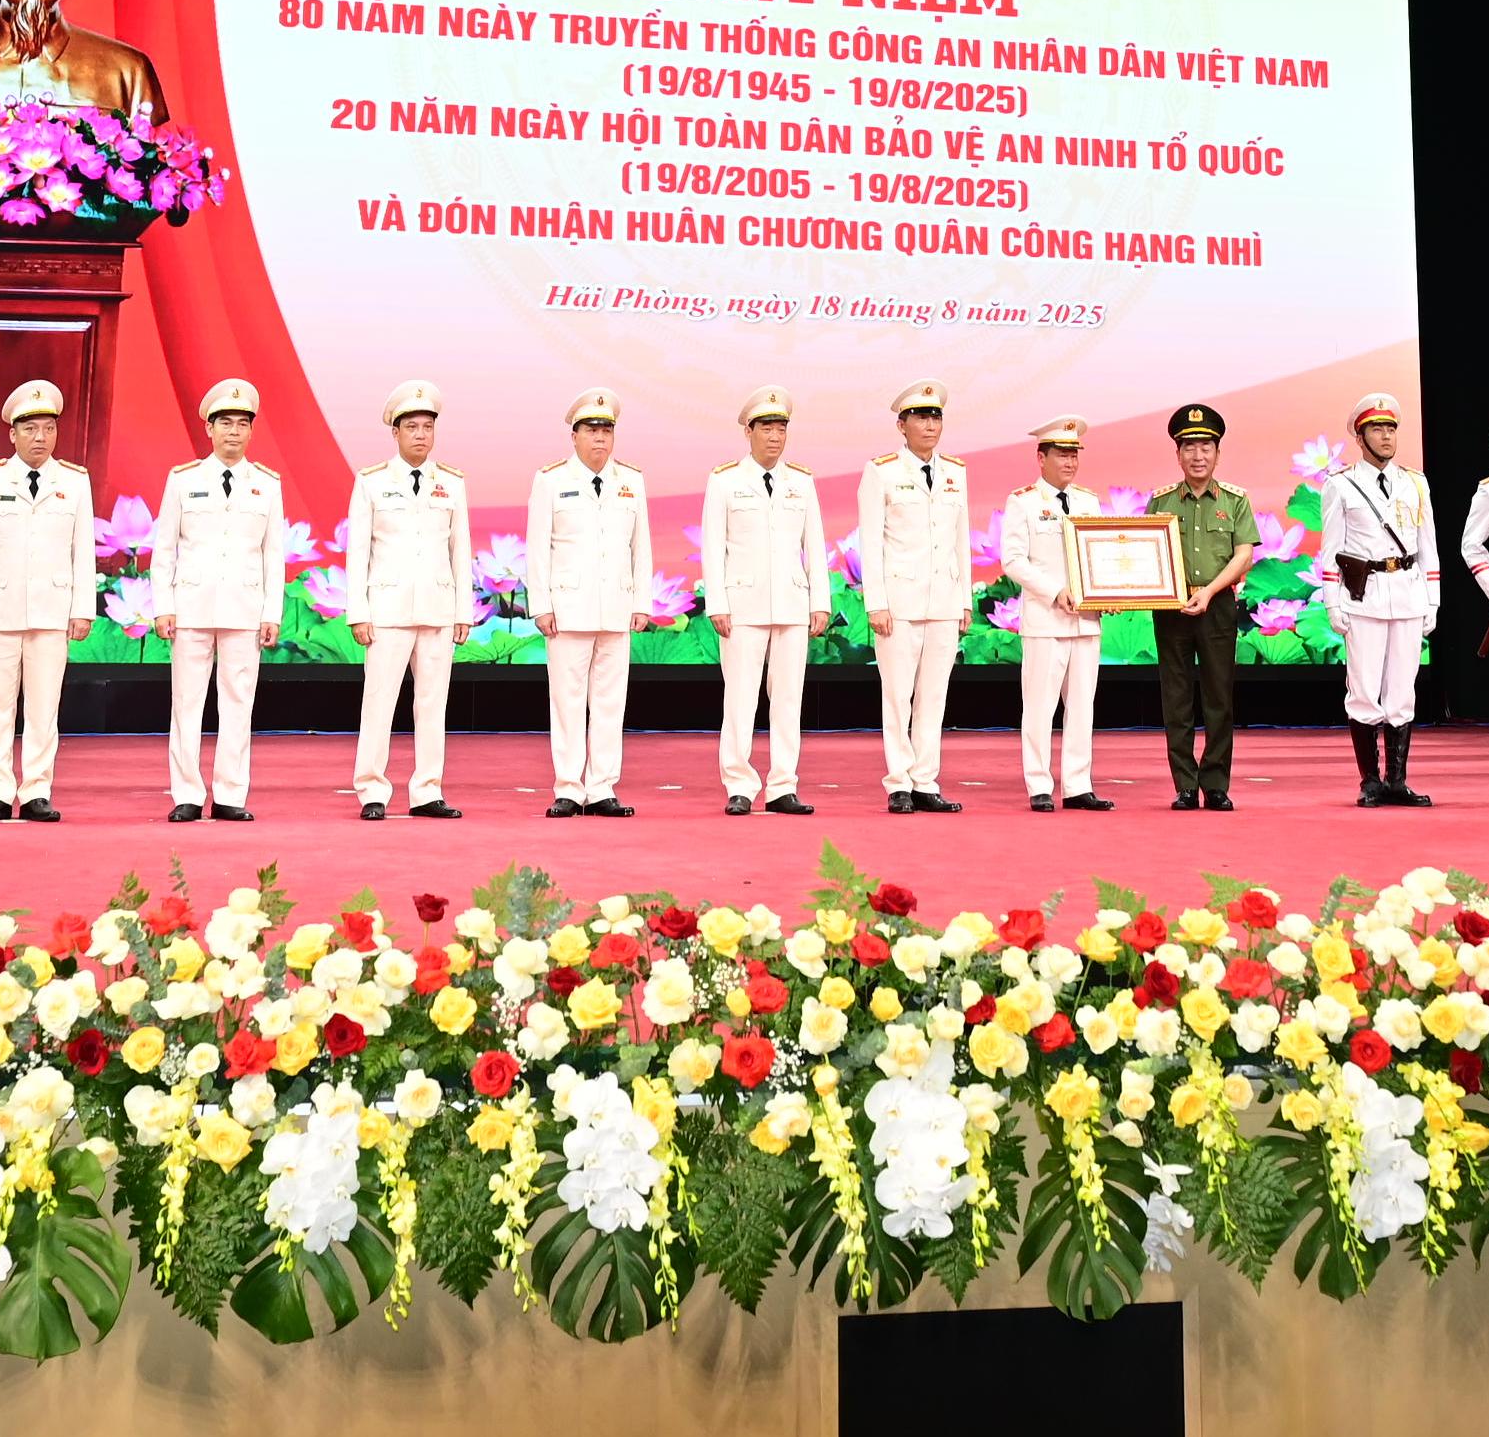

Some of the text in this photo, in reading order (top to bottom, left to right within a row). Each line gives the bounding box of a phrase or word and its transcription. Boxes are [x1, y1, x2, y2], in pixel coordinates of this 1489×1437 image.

[438, 2, 538, 42] NGÀY
[549, 8, 688, 51] TRUYỀN
[699, 15, 816, 58] THỐNG
[828, 25, 923, 65] CÔNG
[933, 37, 981, 68] AN
[993, 37, 1087, 75] NHÂN
[1098, 42, 1166, 80] DÂN
[1176, 47, 1245, 89] VIỆT
[1255, 56, 1329, 89] NAM
[623, 63, 811, 103] (19/8/1945
[848, 76, 1028, 118] 19/8/2025)
[330, 96, 1285, 177] 20 NĂM NGÀY HỘI TOÀN DÂN BẢO VỆ AN NINH TỔ QUỐC
[621, 161, 811, 200] (19/8/2005
[848, 172, 1029, 212] 19/8/2025)
[357, 193, 1262, 269] VÀ ĐÓN NHẬN HUÂN CHƯƠNG QUÂN CÔNG HẠNG NHÌ
[612, 287, 715, 316] Phòng,
[727, 293, 797, 320] ngày
[810, 295, 841, 316] 18
[850, 296, 931, 324] tháng
[941, 300, 958, 319] 8
[966, 301, 1027, 322] năm
[1039, 303, 1103, 324] 2025
